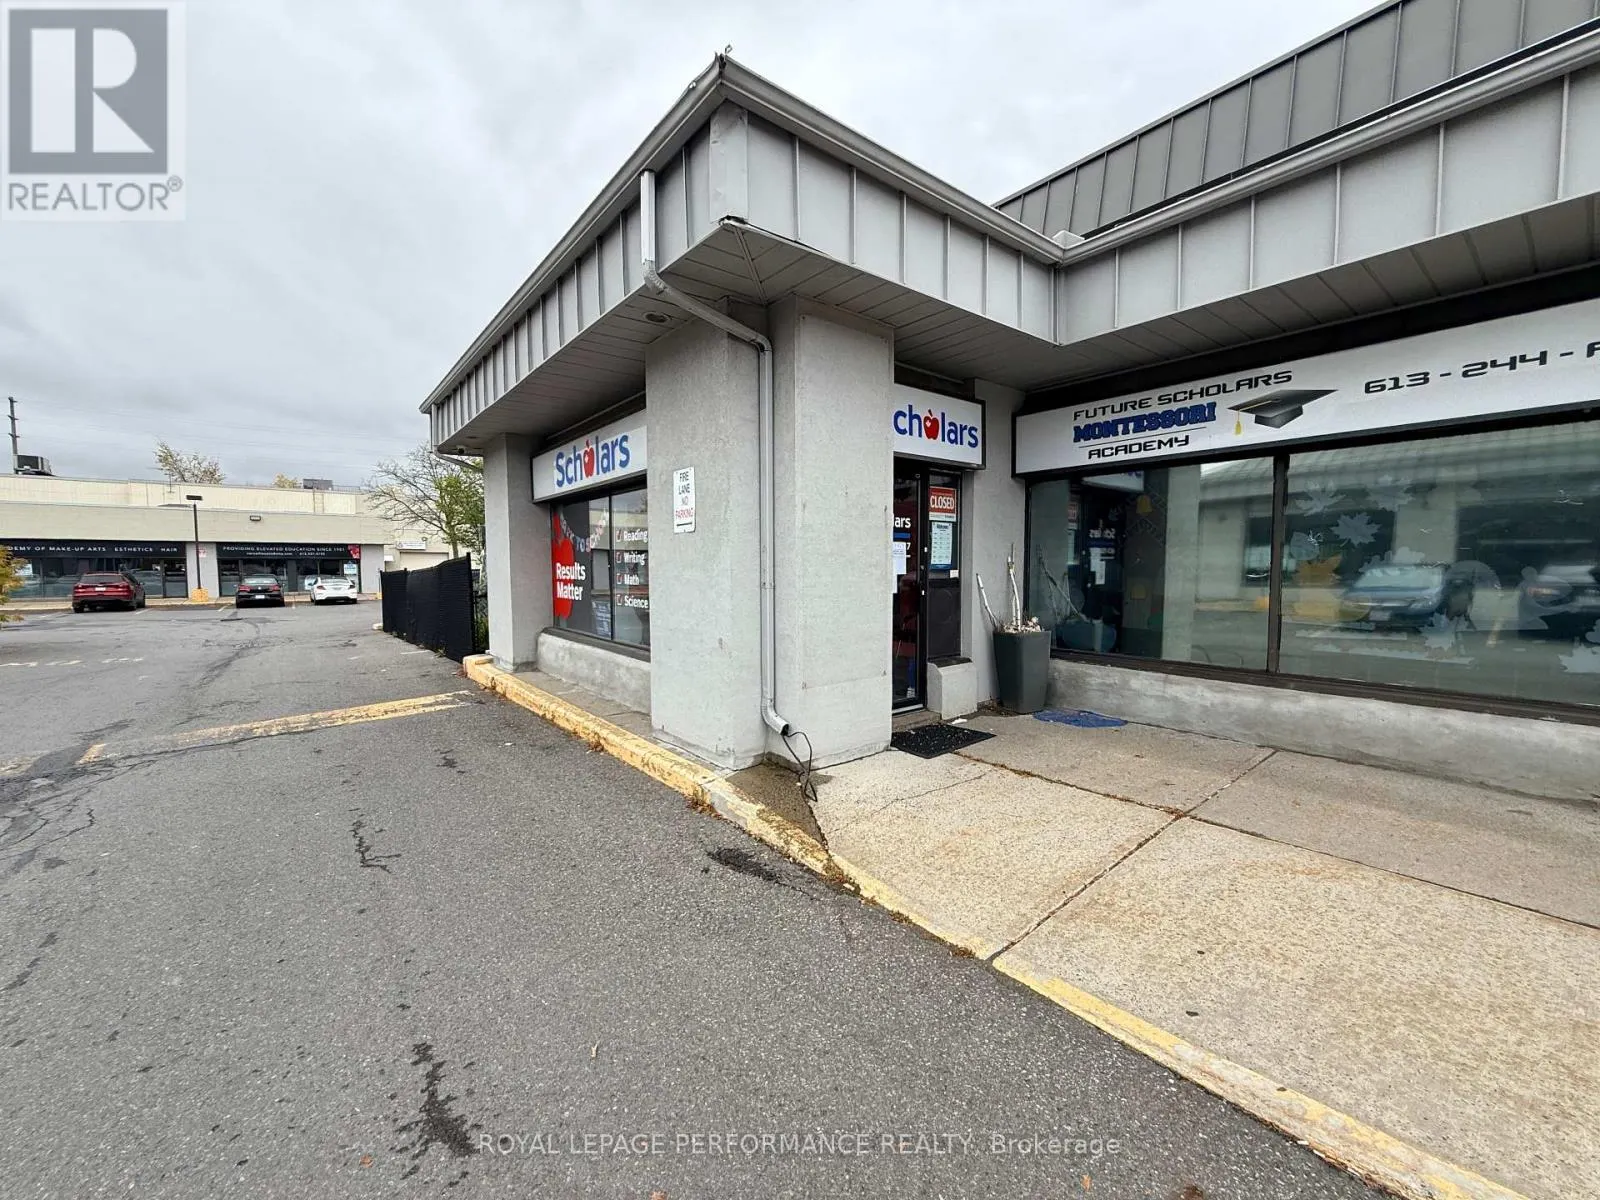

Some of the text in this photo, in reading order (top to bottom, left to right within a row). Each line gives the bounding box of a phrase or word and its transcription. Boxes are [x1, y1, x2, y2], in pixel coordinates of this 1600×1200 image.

[1364, 371, 1430, 394] 613
[1461, 350, 1548, 378] 244
[1073, 370, 1292, 421] FUTURE SCHOLARS
[893, 404, 978, 448] cholars
[1073, 401, 1217, 443] MONTESSORI
[1088, 435, 1190, 460] ACADEMY
[555, 434, 631, 488] Scholars
[679, 483, 690, 495] LANE
[930, 495, 955, 510] CLOSED
[894, 516, 912, 529] ars
[623, 528, 648, 543] Reading
[623, 551, 646, 566] Writing
[556, 562, 586, 581] Results
[624, 573, 640, 586] Math
[557, 581, 584, 601] Matter
[624, 595, 649, 609] Science
